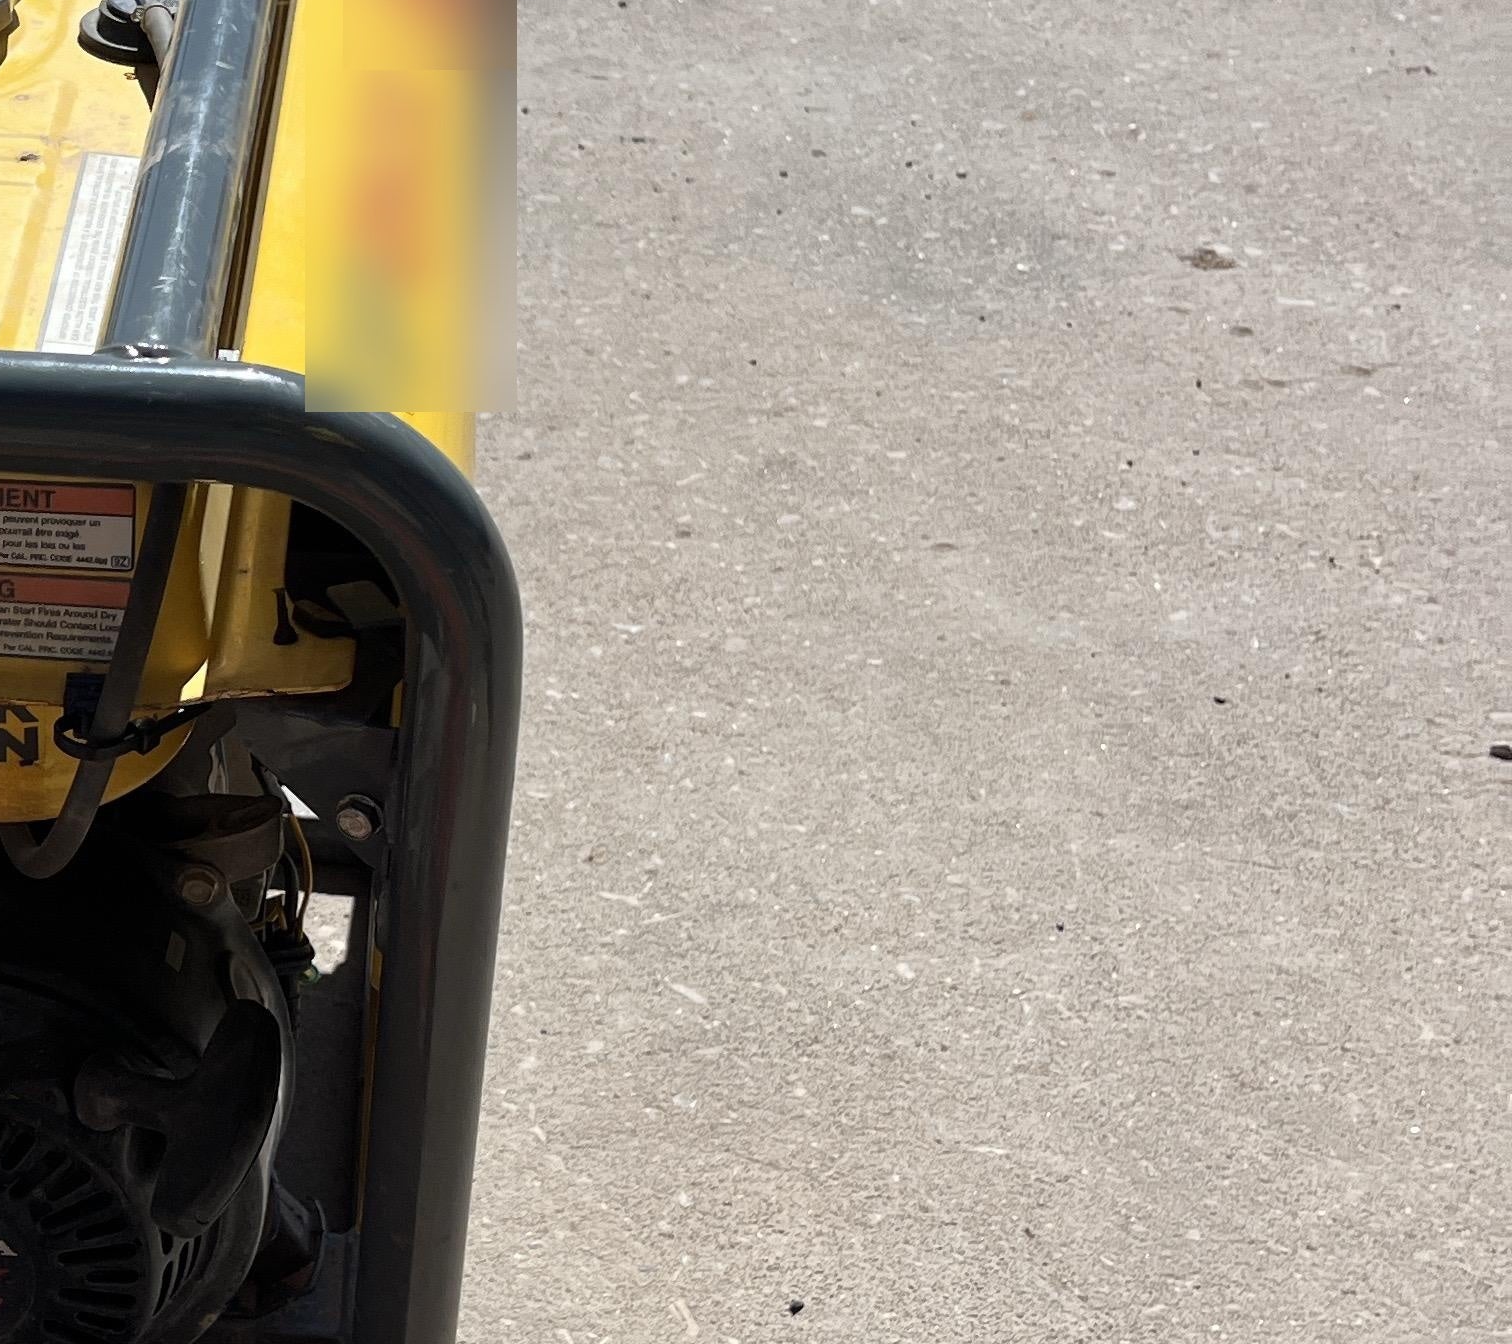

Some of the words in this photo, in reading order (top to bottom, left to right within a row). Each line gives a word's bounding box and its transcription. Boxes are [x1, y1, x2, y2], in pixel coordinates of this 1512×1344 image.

[63, 608, 98, 619] Around
[100, 611, 117, 621] Dry
[23, 618, 57, 628] Should
